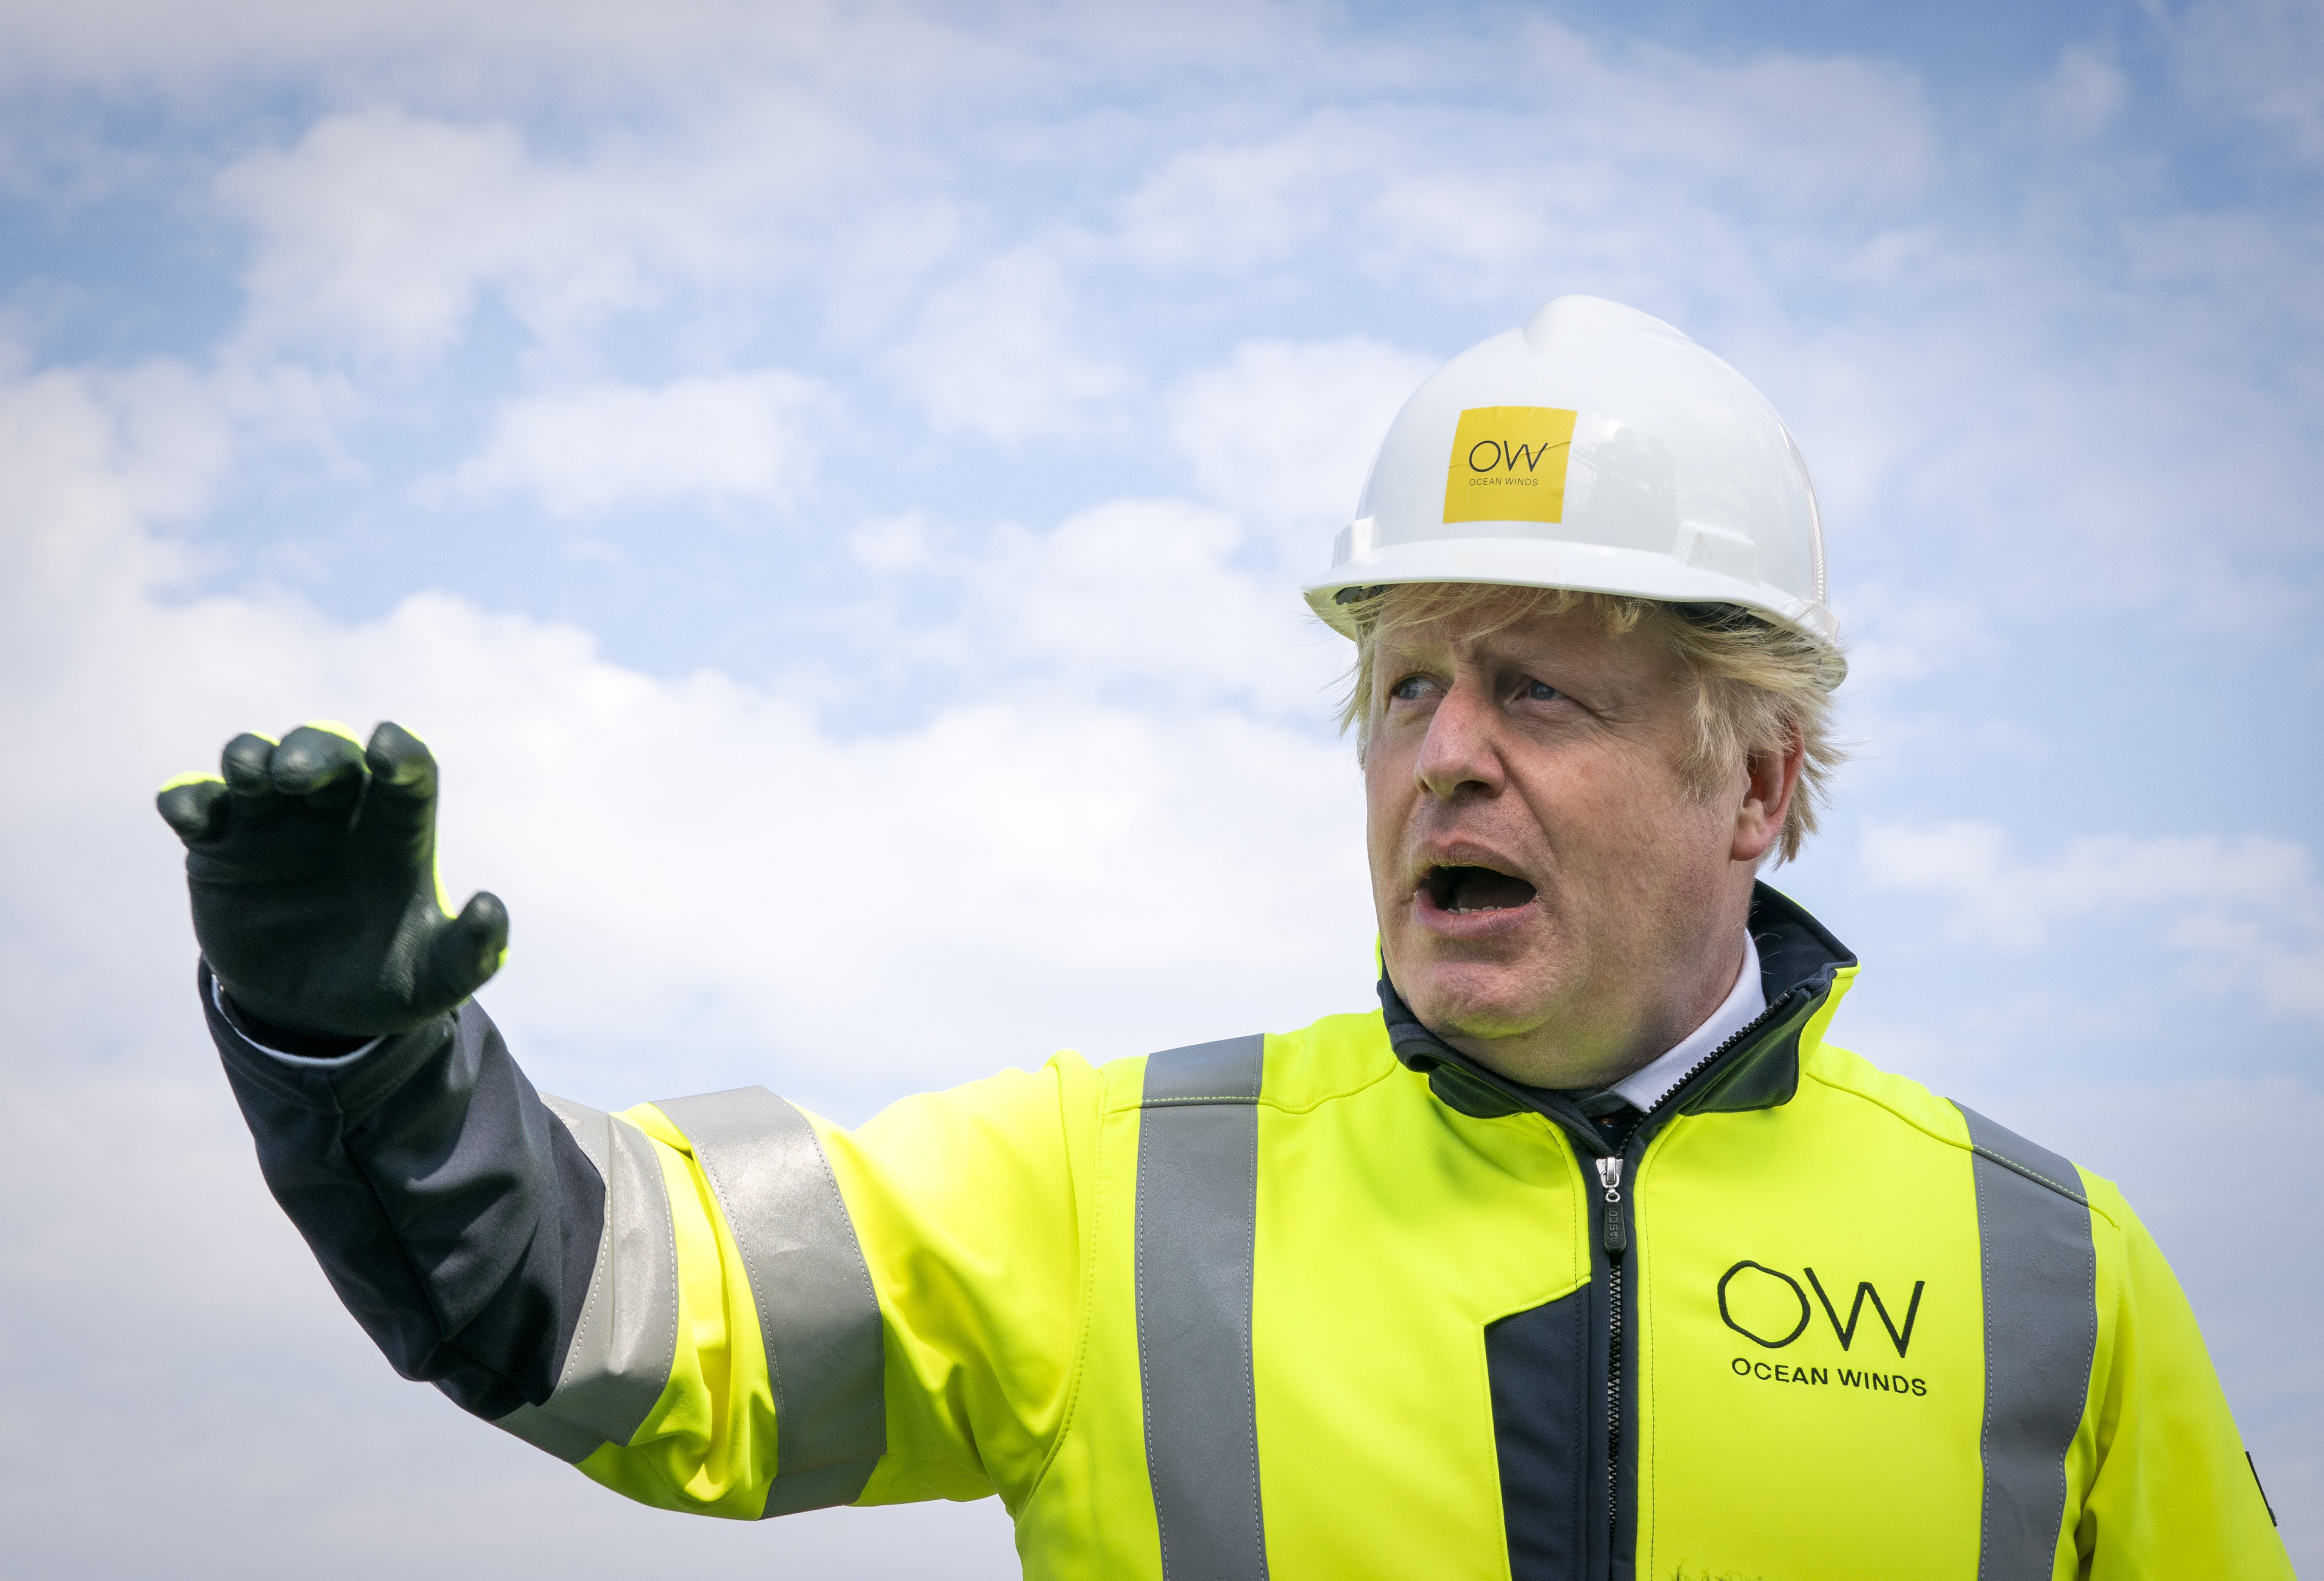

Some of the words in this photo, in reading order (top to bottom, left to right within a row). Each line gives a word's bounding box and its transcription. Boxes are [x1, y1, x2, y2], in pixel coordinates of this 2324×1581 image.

[1469, 440, 1548, 473] OW
[1469, 477, 1502, 486] OCEAN
[1505, 478, 1538, 486] WINDS
[1608, 1206, 1619, 1246] MASCOT
[1717, 1260, 1925, 1358] OW
[1732, 1357, 1828, 1385] OCEAN
[1837, 1368, 1927, 1396] WINDS
